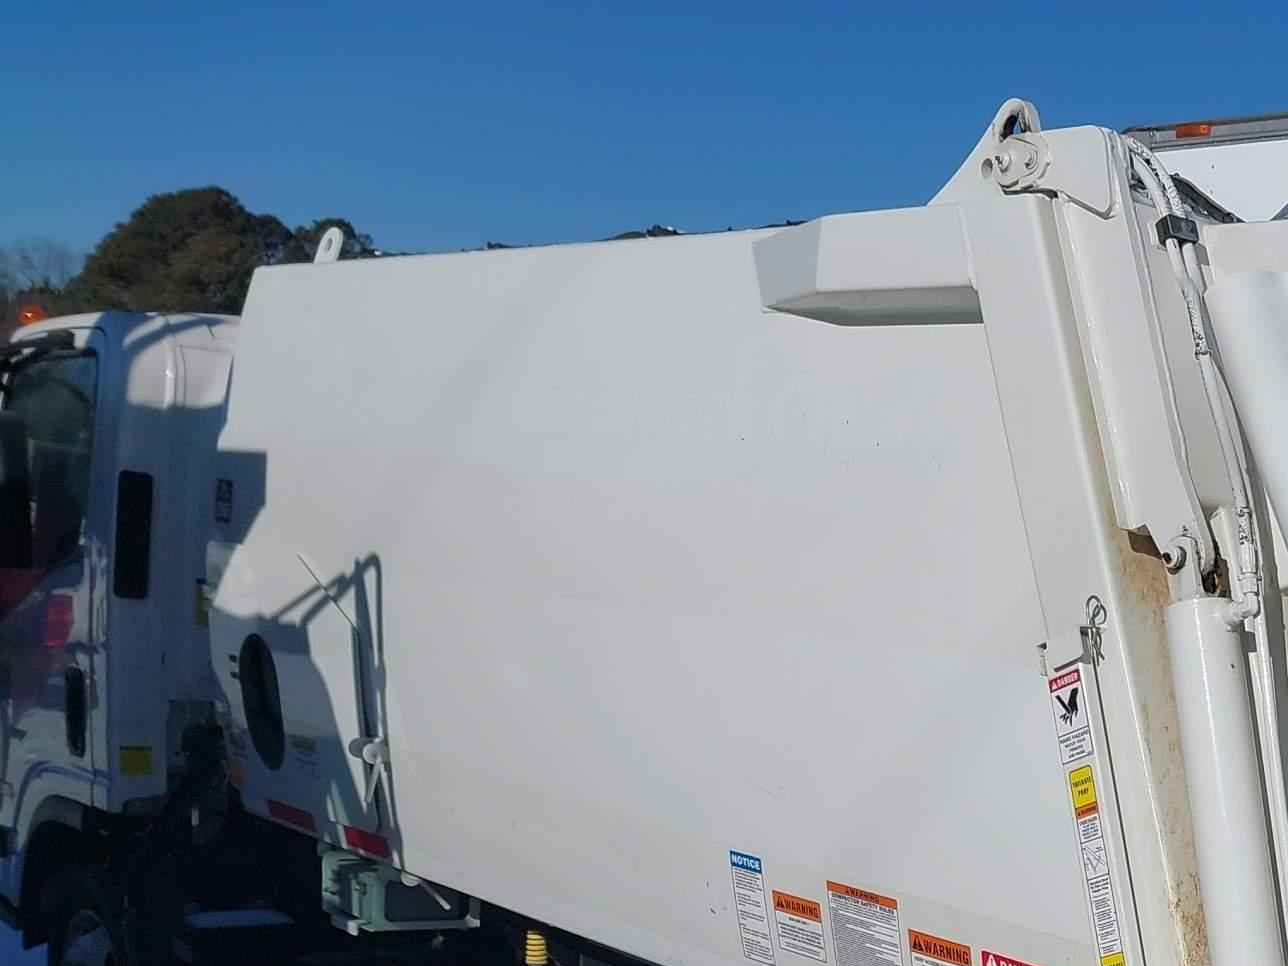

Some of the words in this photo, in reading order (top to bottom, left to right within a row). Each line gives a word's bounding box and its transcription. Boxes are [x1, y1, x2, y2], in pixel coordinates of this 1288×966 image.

[731, 854, 760, 870] NOTICE
[784, 898, 818, 918] WARNING
[923, 939, 968, 964] WARNING
